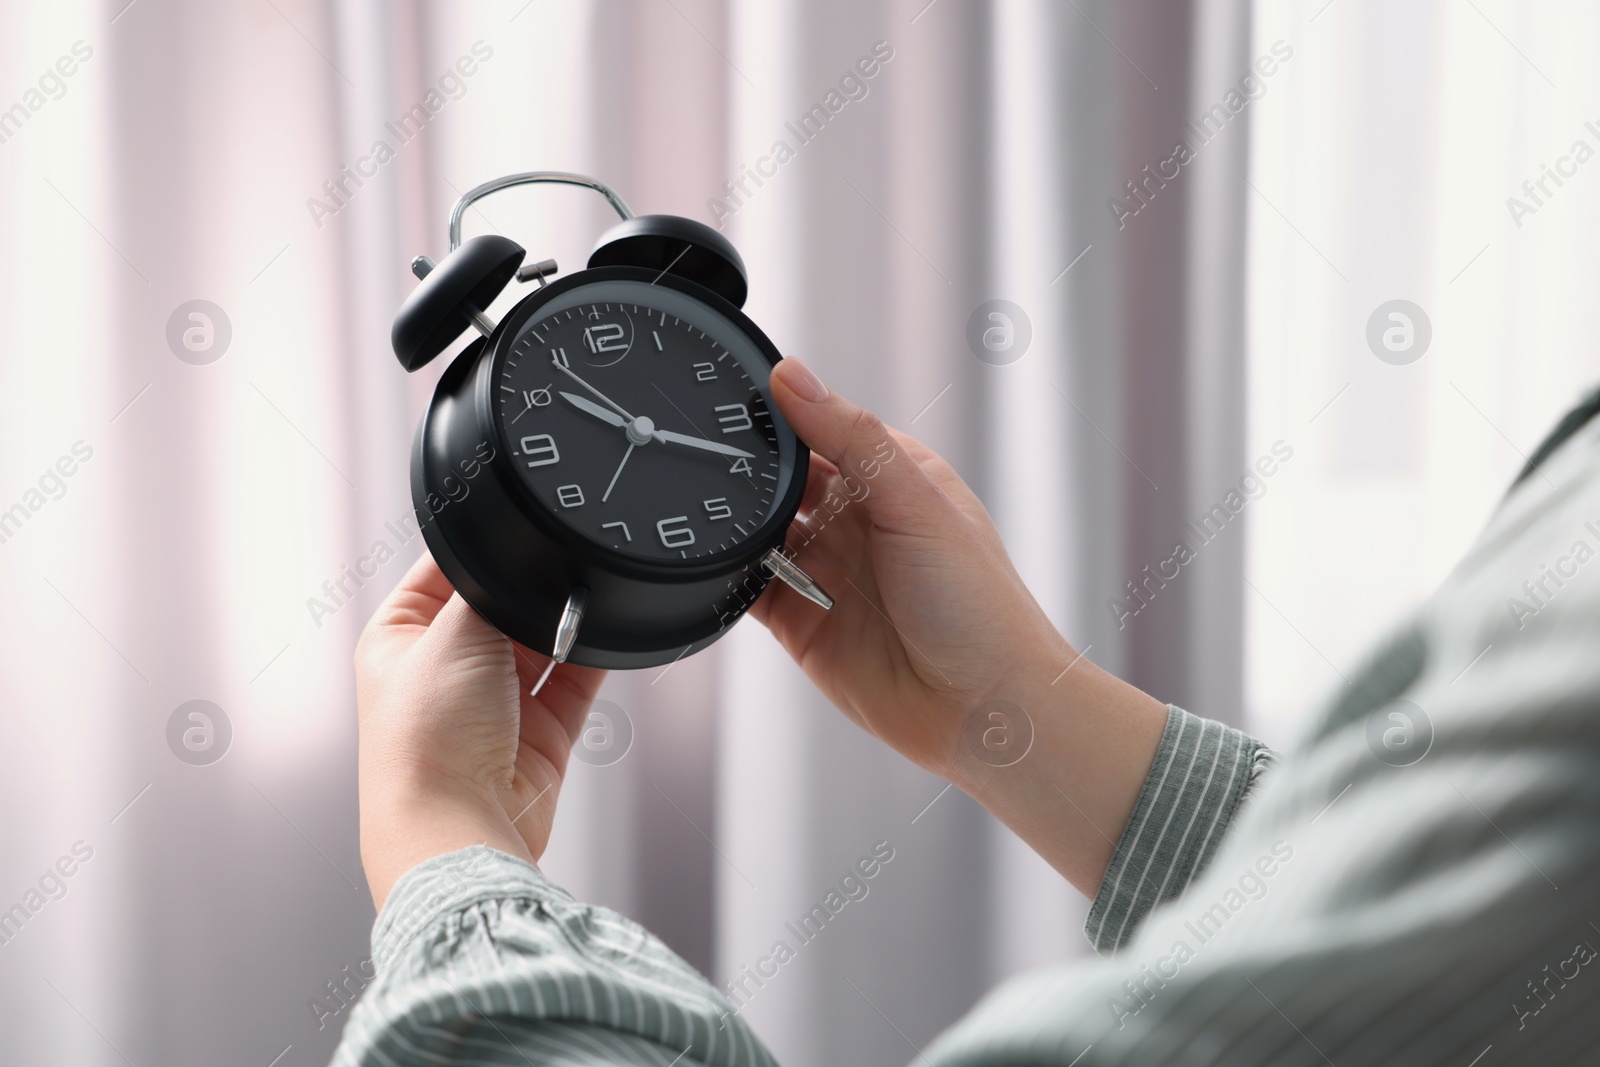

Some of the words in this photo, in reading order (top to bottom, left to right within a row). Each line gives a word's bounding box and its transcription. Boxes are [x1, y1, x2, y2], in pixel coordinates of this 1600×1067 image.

[585, 323, 629, 353] 12
[652, 330, 663, 351] 1
[551, 347, 570, 370] 11
[693, 361, 718, 382] 2
[522, 388, 552, 409] 10
[714, 403, 753, 434] 3
[520, 433, 560, 468] 9
[729, 457, 753, 478] 4
[556, 483, 585, 508] 8
[703, 497, 732, 521] 5
[602, 521, 632, 542] 7
[656, 515, 696, 548] 6
